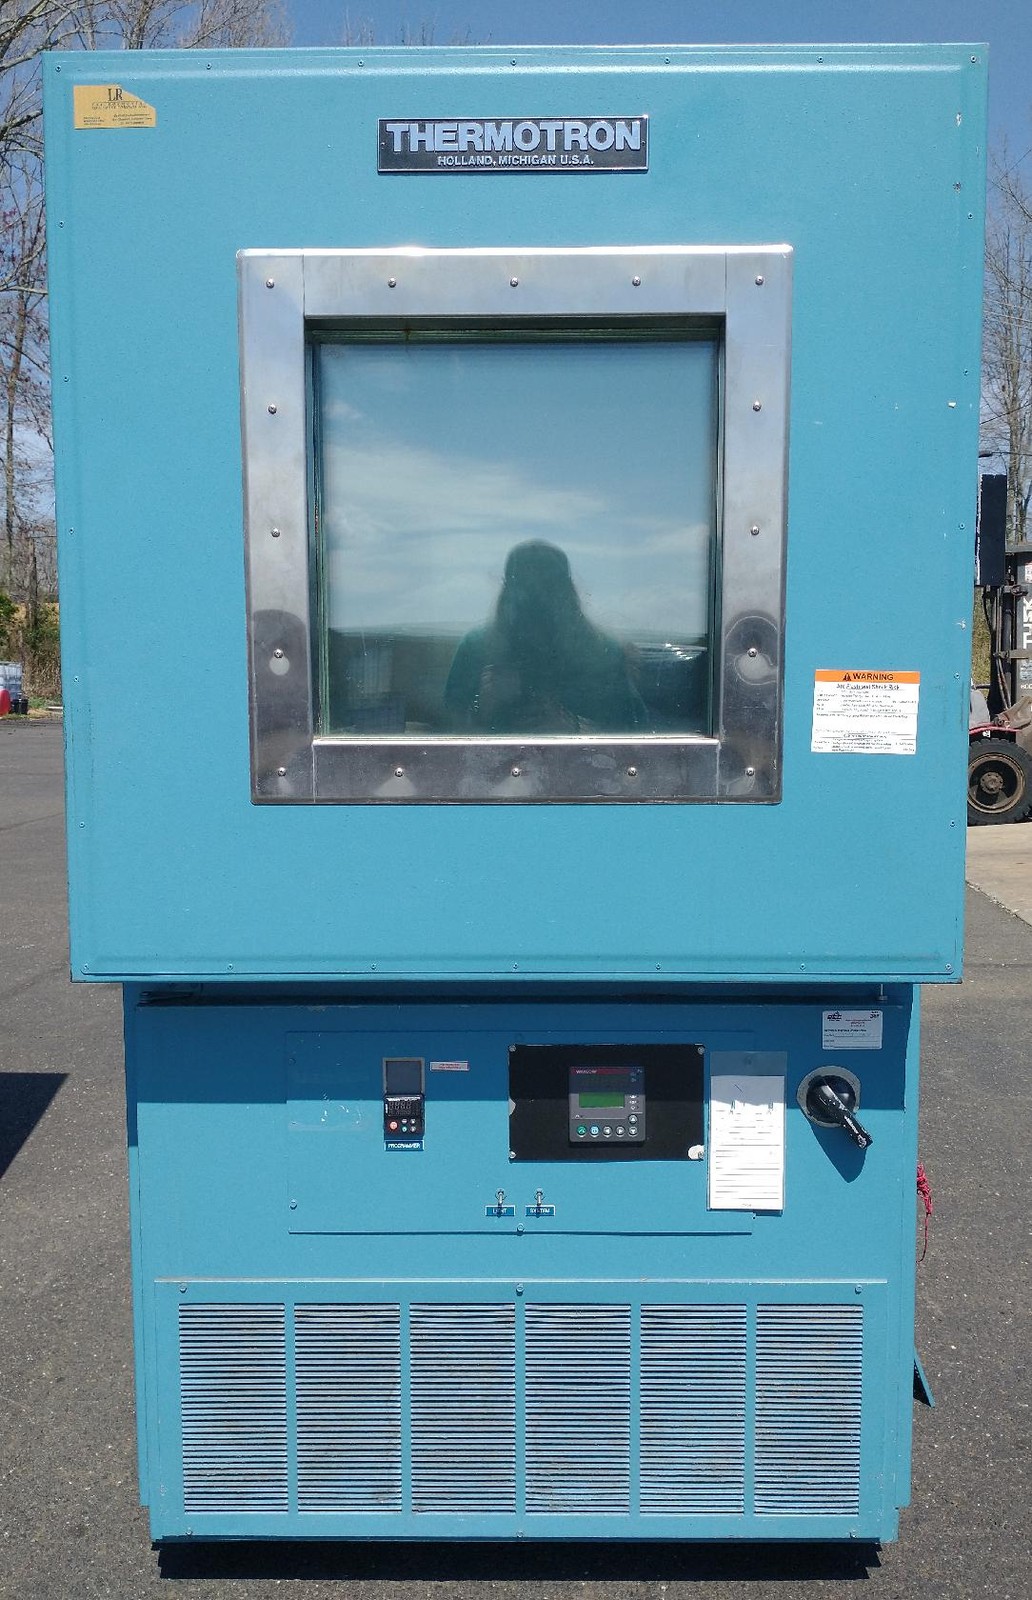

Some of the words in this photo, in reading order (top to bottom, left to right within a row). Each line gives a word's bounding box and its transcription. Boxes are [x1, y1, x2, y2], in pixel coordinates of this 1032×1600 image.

[107, 88, 123, 101] LR
[385, 121, 641, 152] THERMOTRON
[437, 154, 497, 168] HOLLAND,
[498, 154, 557, 166] MICHIGAN
[560, 154, 595, 166] U.S.A.
[852, 672, 894, 681] WARNING
